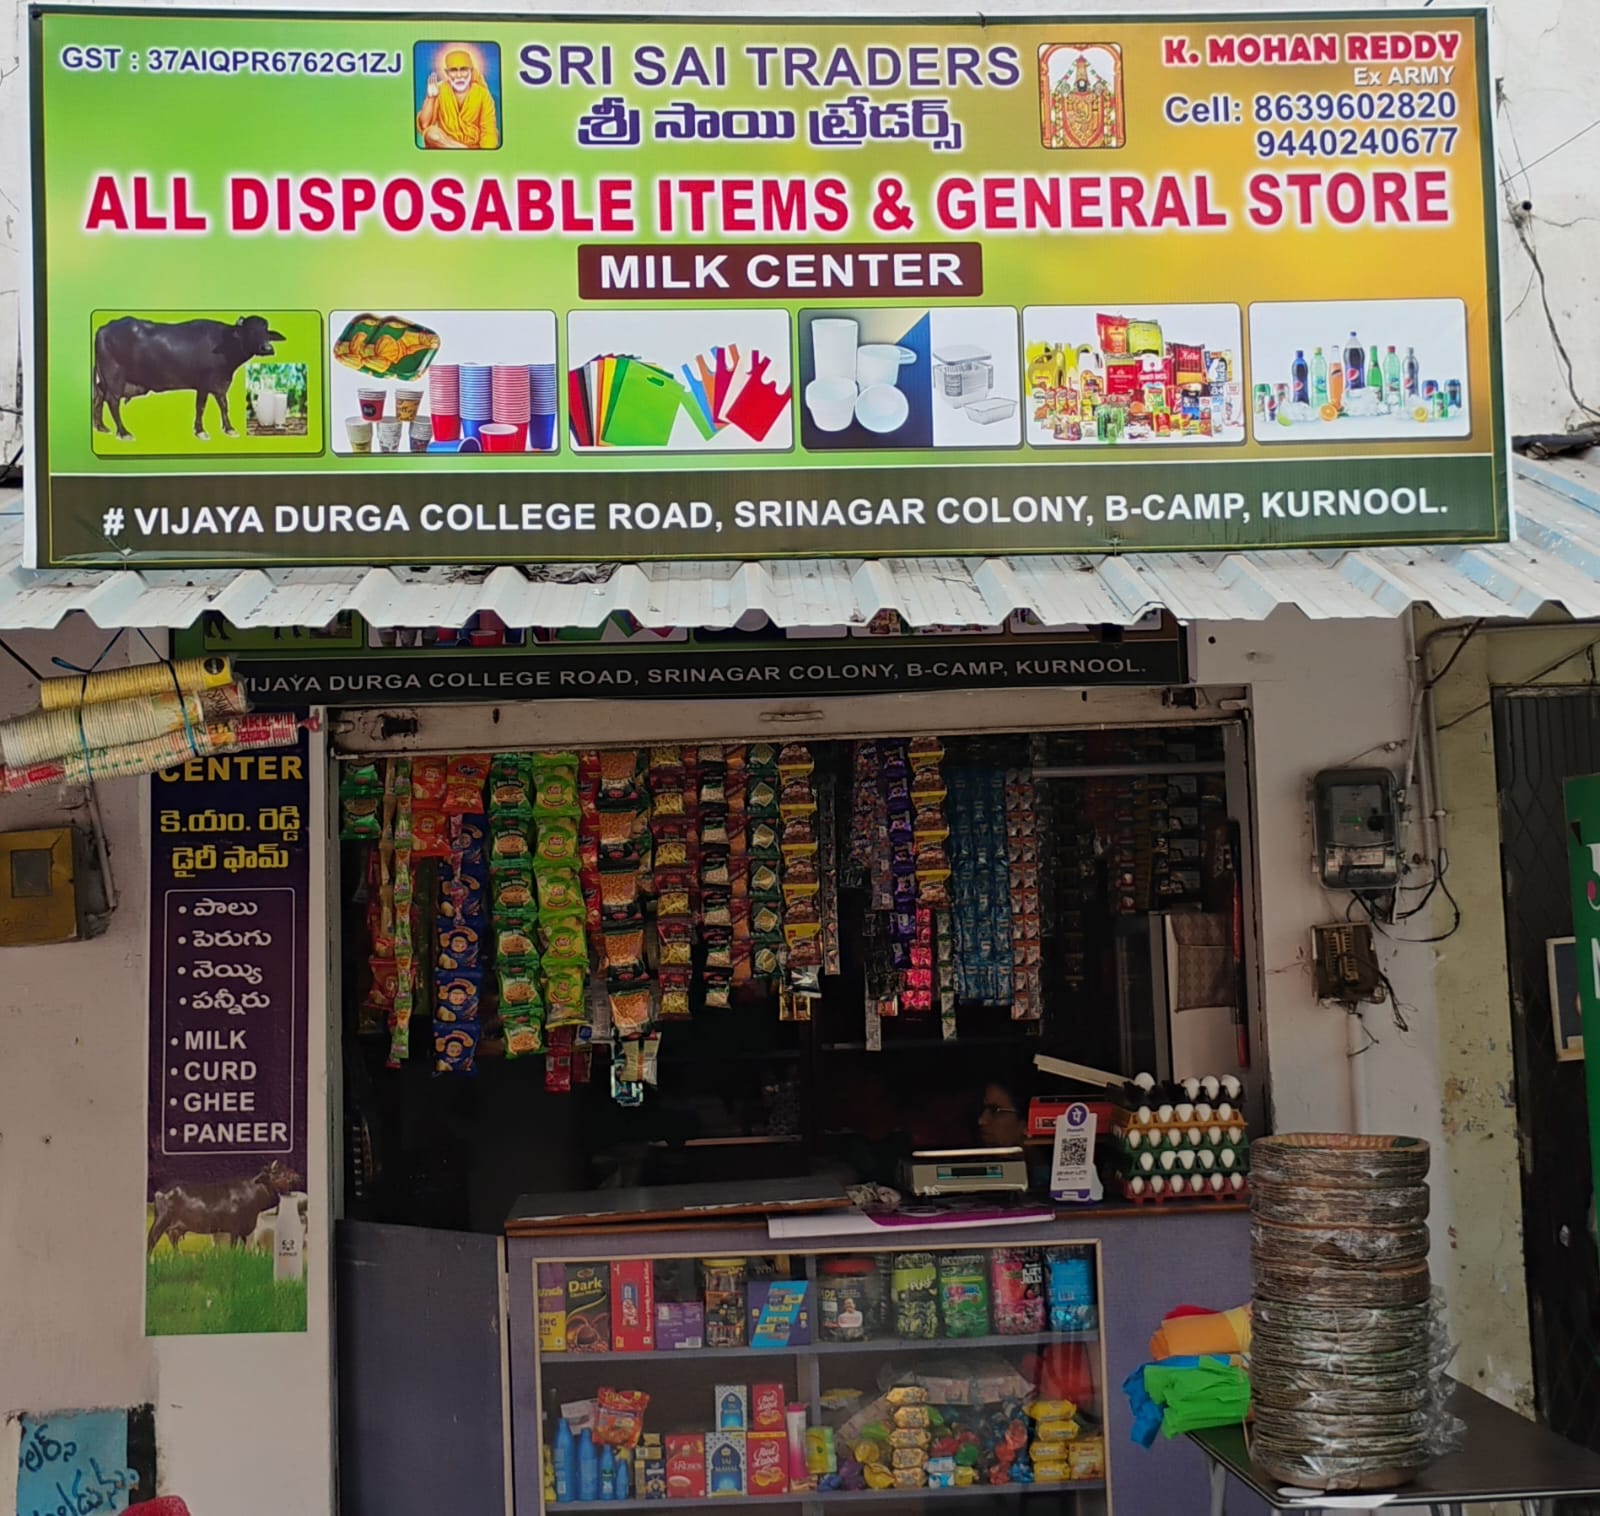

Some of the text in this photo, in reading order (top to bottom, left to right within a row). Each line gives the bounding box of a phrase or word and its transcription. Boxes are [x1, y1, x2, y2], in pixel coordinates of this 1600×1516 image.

[62, 47, 121, 70] GST
[148, 49, 402, 74] 37AIQPR6762G1ZJ
[1165, 33, 1460, 65] K. MOHAN REDDY
[519, 44, 1020, 87] SRI SAI TRADERS
[1354, 66, 1454, 86] Ex ARMY
[1165, 91, 1456, 123] Cell: 8639602820
[577, 96, 963, 151] శ్రీ సాయి ట్రేడర్స్
[1256, 127, 1458, 157] 9440240677
[85, 170, 1449, 232] ALL DISPOSABLE ITEMS & GENERAL STORE
[600, 251, 964, 290] MILK CENTER
[134, 505, 265, 536] VIJAYA
[275, 503, 410, 533] DURGA
[420, 501, 597, 532] COLLEGE
[608, 500, 724, 535] ROAD,
[734, 497, 925, 528] SRINAGAR
[936, 494, 1094, 528] COLONY,
[1105, 491, 1250, 525] B-CAMP,
[1260, 487, 1448, 519] KURNOOL.
[329, 672, 421, 691] DURGA
[429, 670, 551, 689] COLLEGE
[560, 669, 640, 687] ROAD,
[647, 665, 780, 684] SRINAGAR
[789, 663, 899, 681] COLONY,
[907, 660, 1008, 678] B-CAMP,
[1016, 658, 1146, 675] KURNOOL.
[193, 898, 258, 916] పాలు
[192, 930, 272, 948] పెరుగు
[184, 1030, 247, 1050] MILK
[183, 1061, 257, 1081] CURD
[183, 1092, 255, 1112] GHEE
[183, 1122, 288, 1143] PANEER
[568, 1276, 603, 1291] Dark
